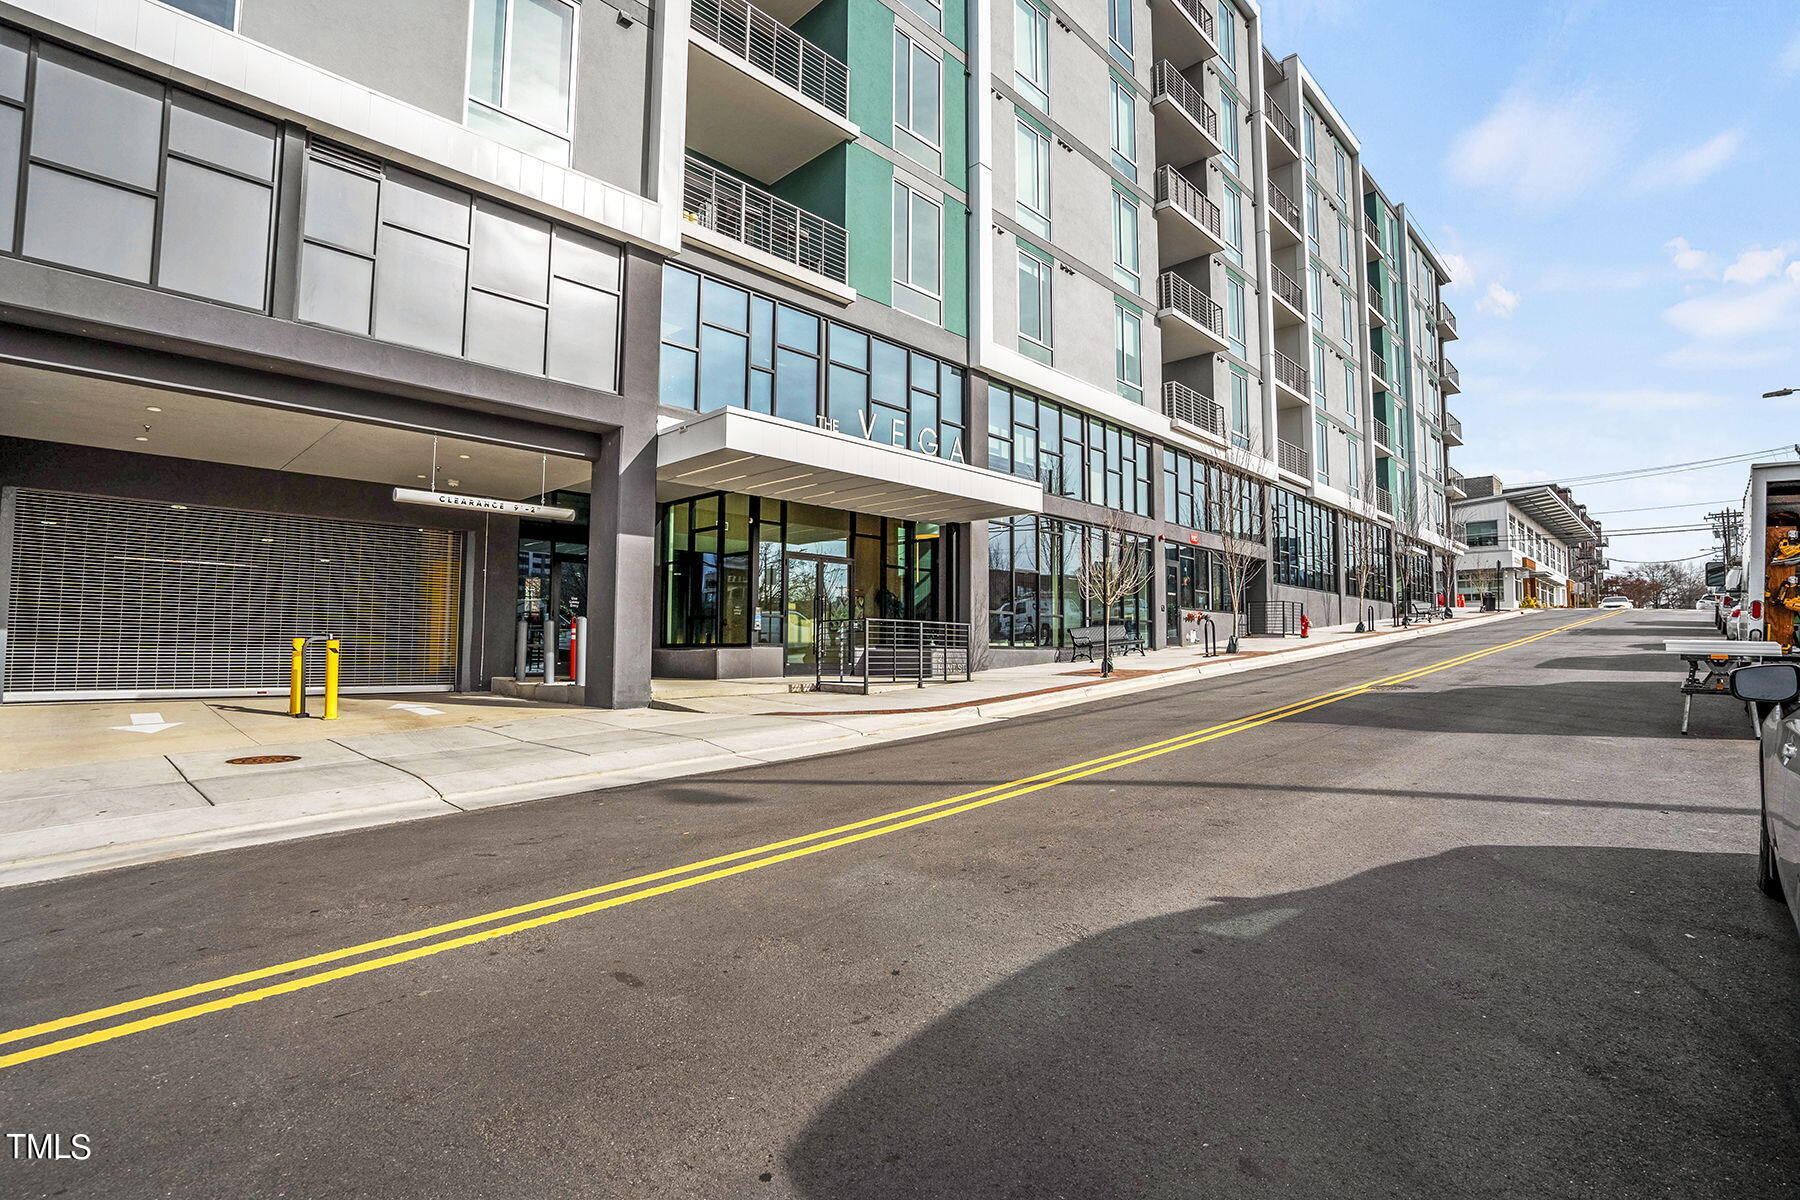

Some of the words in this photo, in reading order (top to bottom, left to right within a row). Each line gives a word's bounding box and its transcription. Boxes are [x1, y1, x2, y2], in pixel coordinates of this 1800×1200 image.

[816, 415, 840, 433] THE
[858, 409, 965, 464] VEGA
[439, 495, 505, 510] CLEARANCE
